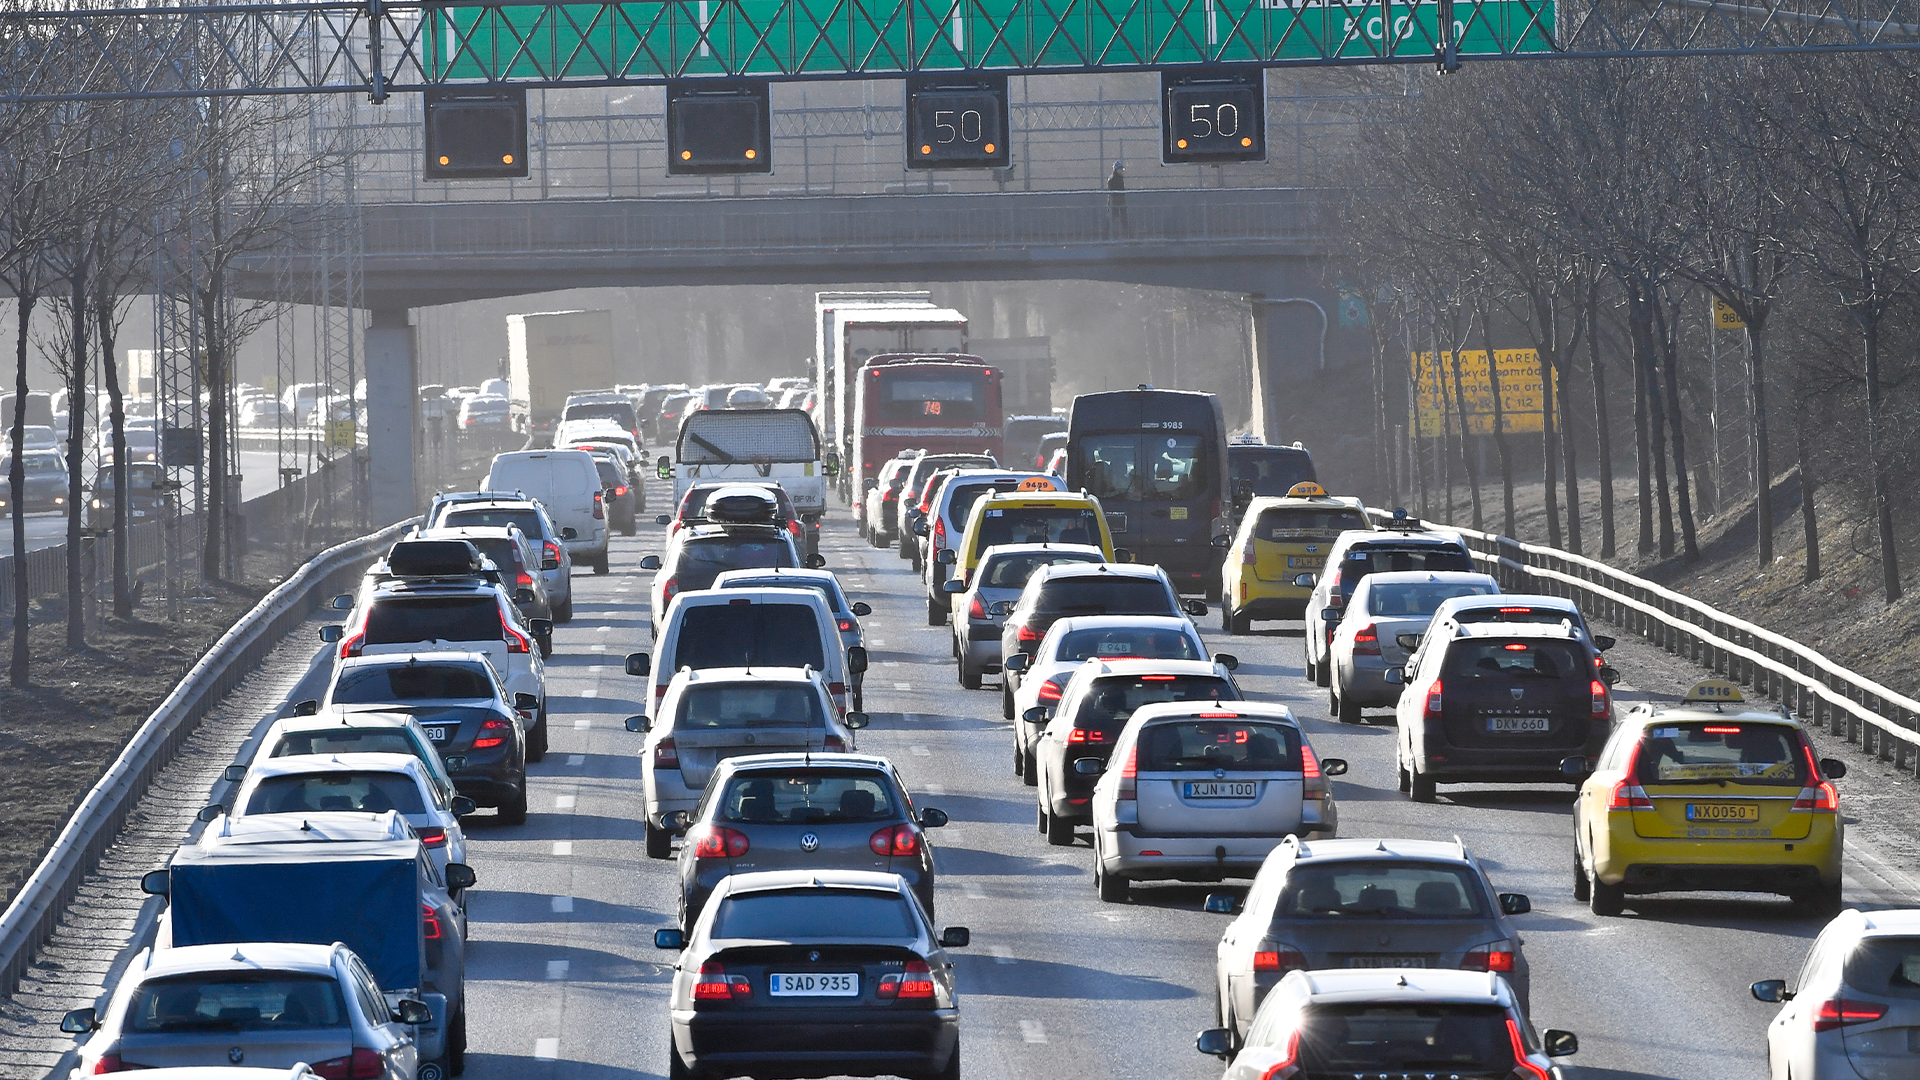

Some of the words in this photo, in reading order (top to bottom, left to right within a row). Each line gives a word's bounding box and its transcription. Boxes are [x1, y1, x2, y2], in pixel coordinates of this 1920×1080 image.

[1343, 15, 1415, 40] 500
[1190, 103, 1239, 138] 50
[934, 110, 981, 144] 50
[1477, 353, 1541, 365] MLAREN
[924, 401, 941, 415] 749
[1517, 398, 1533, 407] 112
[1162, 421, 1183, 430] 3985
[1496, 719, 1519, 729] DKW
[1521, 719, 1544, 729] 660
[427, 728, 443, 739] 60
[1192, 783, 1219, 796] XJN
[1228, 783, 1252, 795] 100
[1749, 808, 1755, 816] T
[785, 976, 815, 991] SAD
[821, 976, 851, 991] 935
